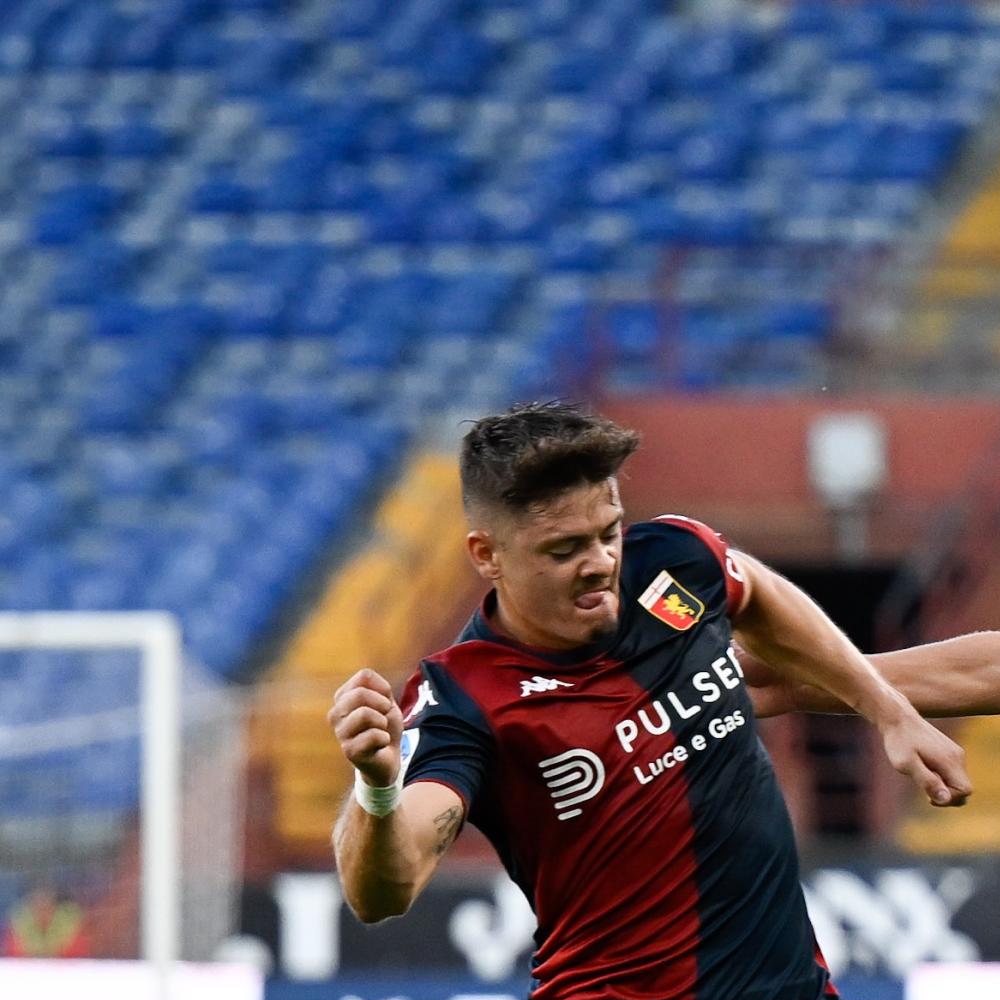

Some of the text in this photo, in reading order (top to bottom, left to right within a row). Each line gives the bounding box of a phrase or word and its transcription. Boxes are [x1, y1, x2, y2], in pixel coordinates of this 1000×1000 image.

[633, 709, 746, 785] Luce e Gas
